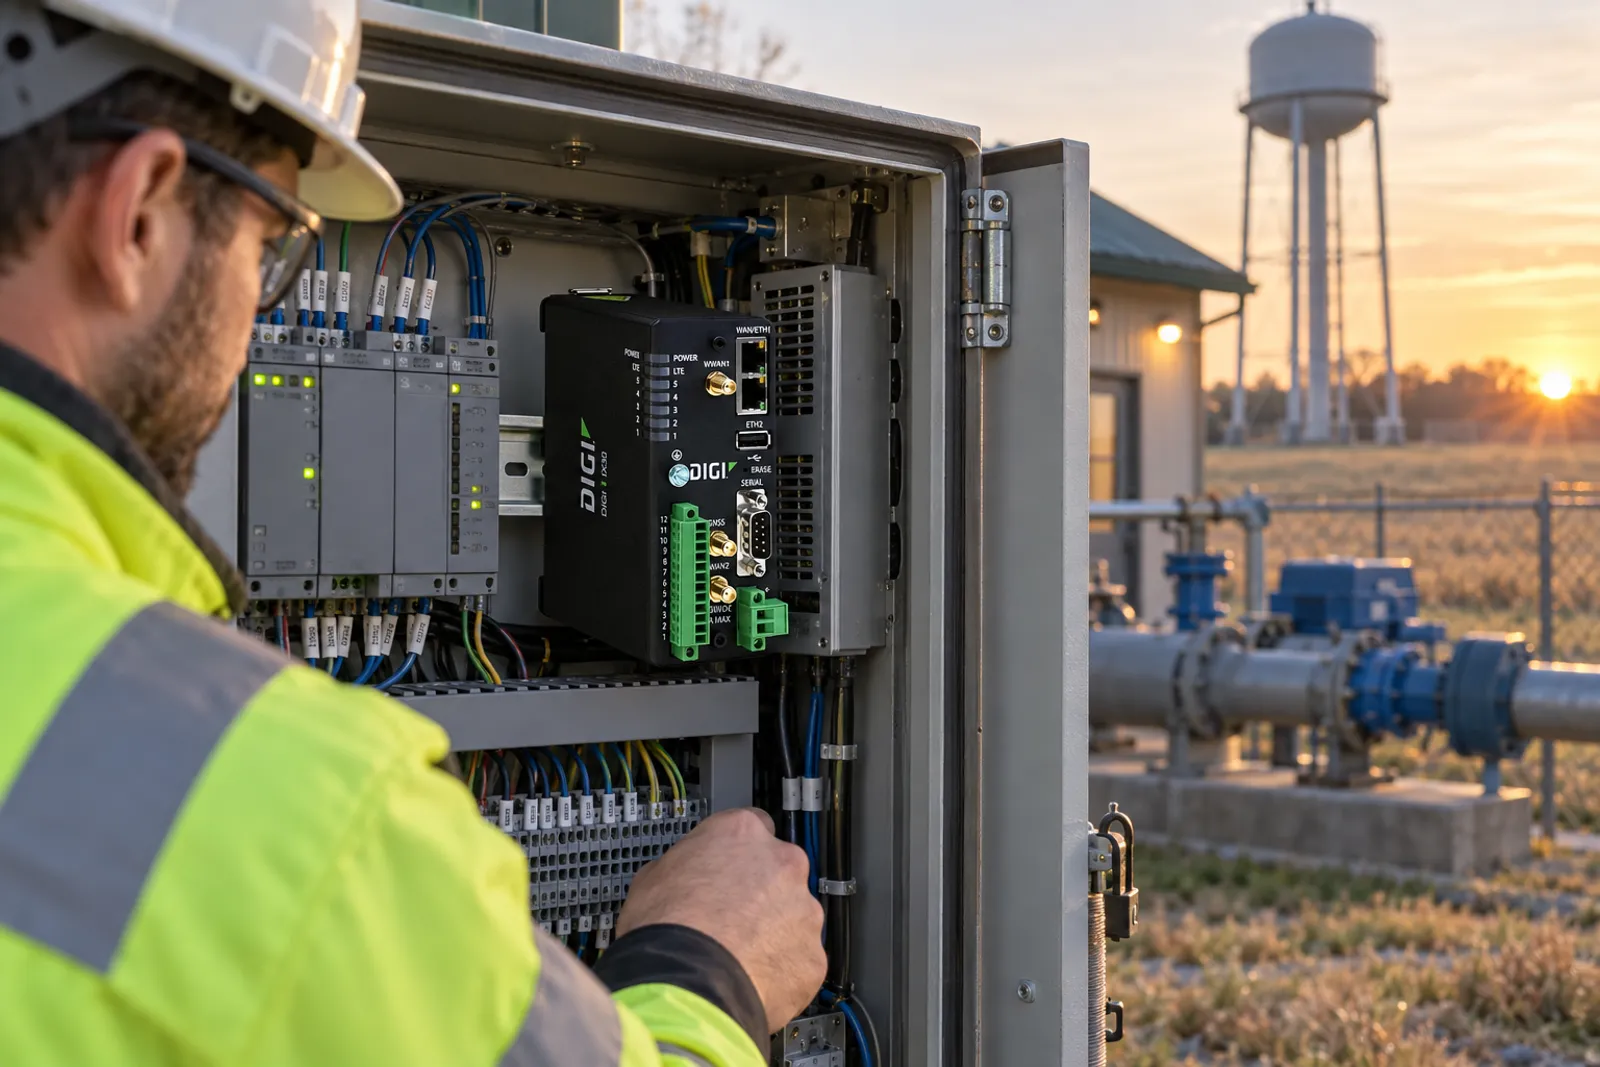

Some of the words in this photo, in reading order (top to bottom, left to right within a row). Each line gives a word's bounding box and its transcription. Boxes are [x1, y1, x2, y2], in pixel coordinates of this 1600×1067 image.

[673, 367, 685, 375] LTE
[673, 380, 678, 388] 5
[673, 393, 678, 401] 4
[673, 406, 678, 414] 3
[673, 419, 678, 428] 2
[746, 420, 764, 428] ETH2
[673, 432, 677, 440] 1
[690, 462, 726, 480] DIGI
[580, 440, 596, 513] DIGI
[660, 516, 668, 524] 12
[660, 537, 668, 545] 10
[662, 611, 667, 620] 3
[662, 622, 667, 630] 2
